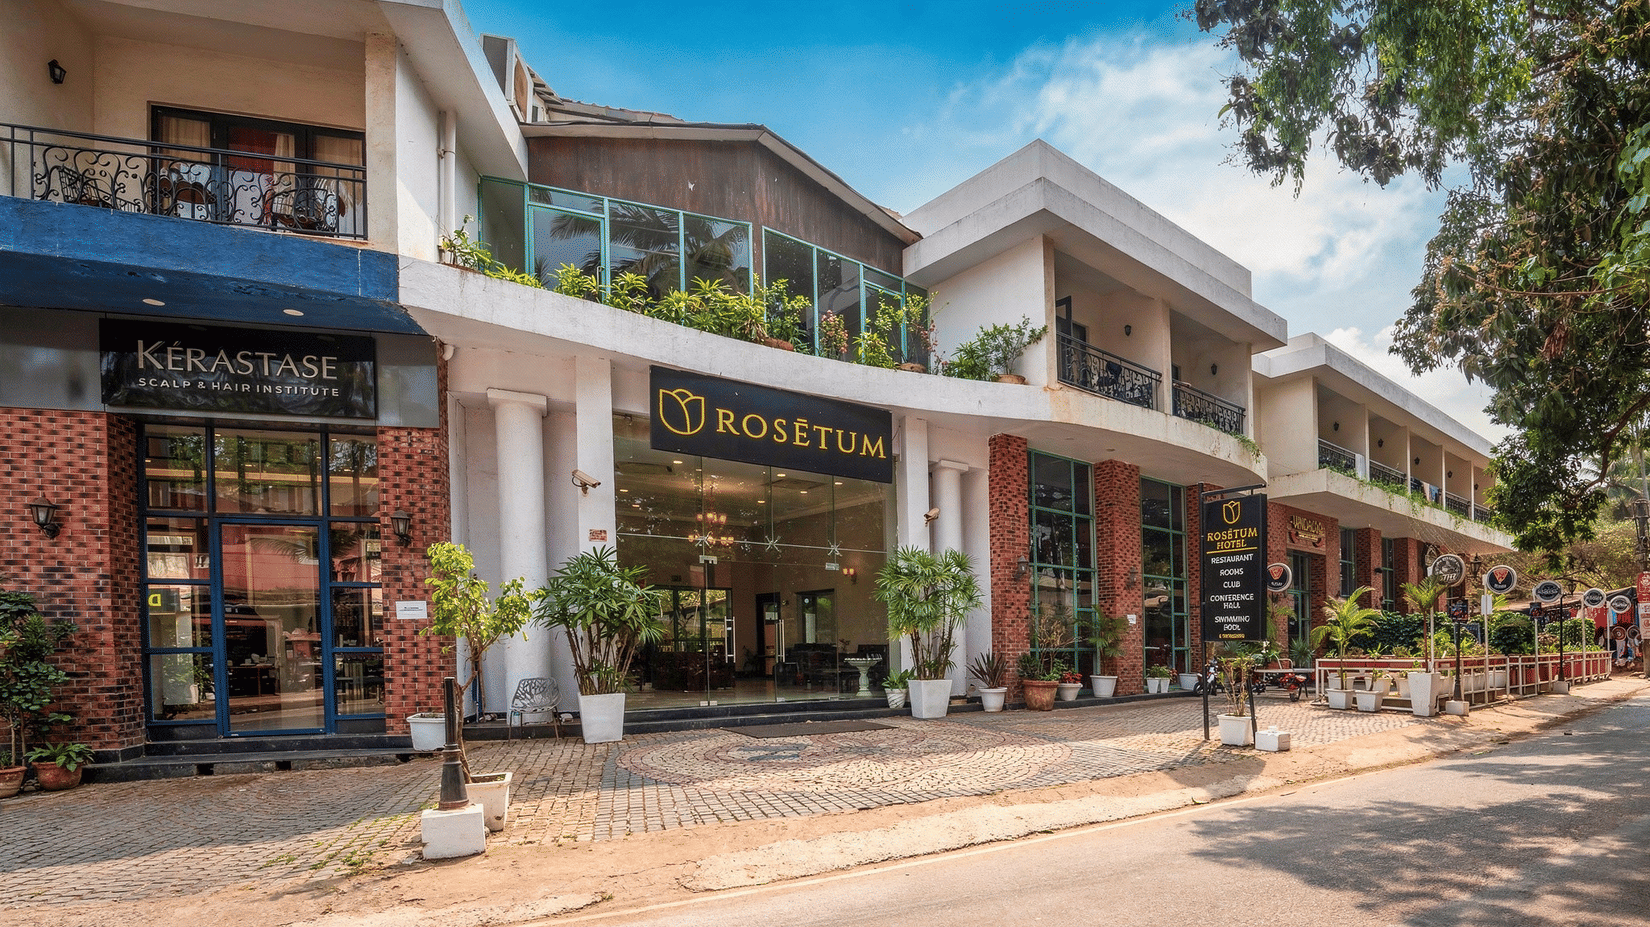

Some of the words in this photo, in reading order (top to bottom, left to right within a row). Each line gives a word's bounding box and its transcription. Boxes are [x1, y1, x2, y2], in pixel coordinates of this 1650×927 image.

[137, 339, 338, 380] KÉRASTASE
[138, 377, 191, 389] SCALP
[197, 381, 206, 390] &
[211, 381, 251, 393] HAIR
[256, 384, 339, 397] INSTITUTE
[715, 407, 887, 459] ROSĒTUM
[1217, 539, 1247, 549] HOTEL
[1211, 554, 1254, 564] RESTAURANT
[1219, 567, 1244, 576] ROOMS
[1222, 580, 1241, 588] CLUB
[1209, 593, 1255, 602] CONFERENCE
[1214, 615, 1250, 623] SWIMMING
[1223, 623, 1241, 631] POOL
